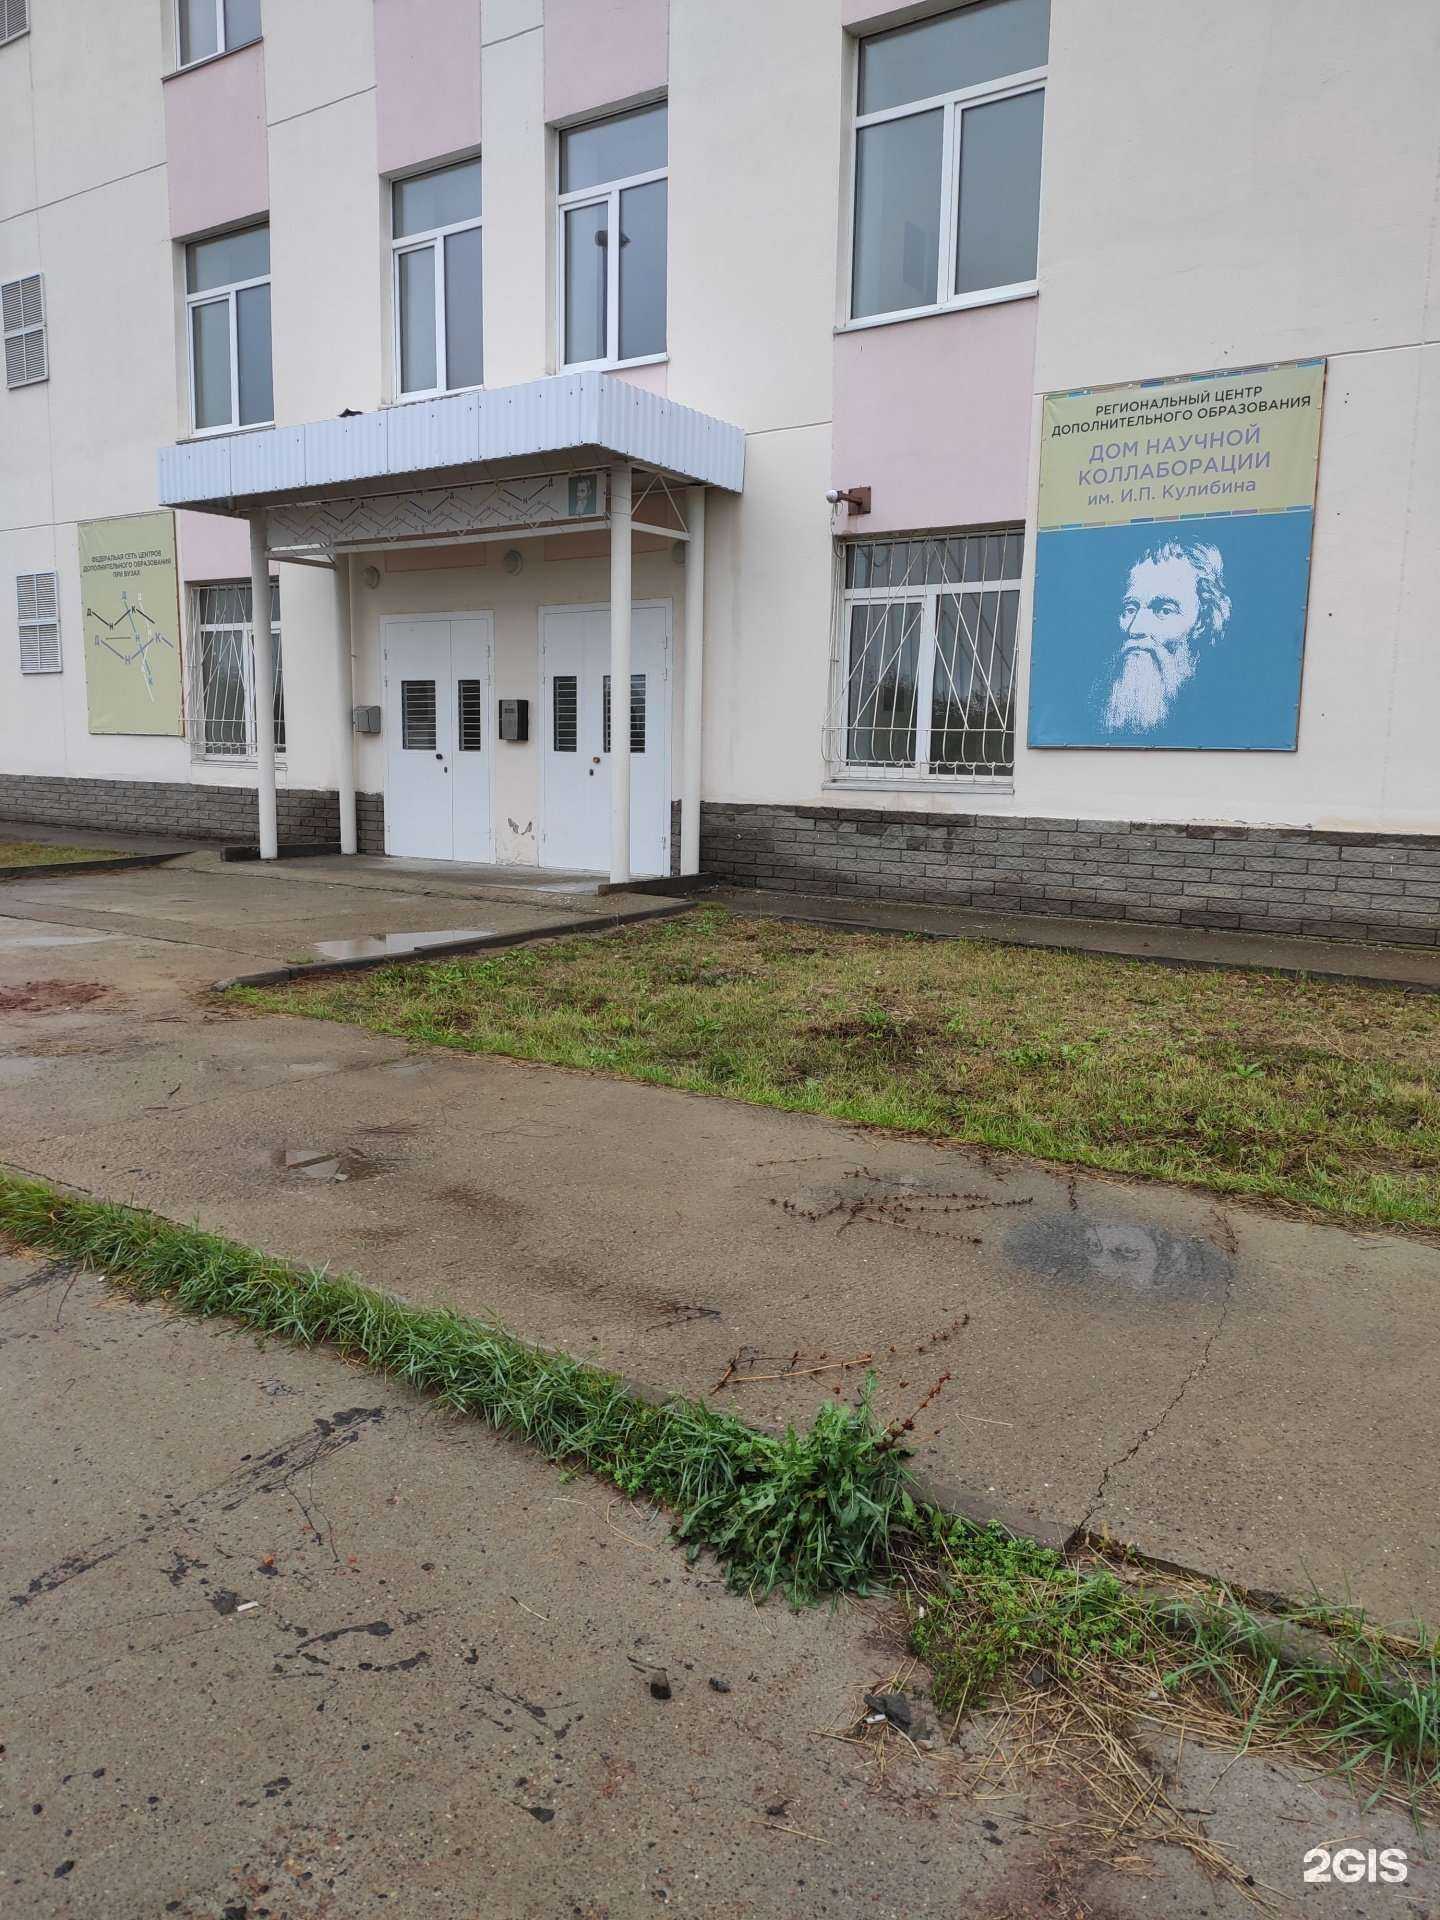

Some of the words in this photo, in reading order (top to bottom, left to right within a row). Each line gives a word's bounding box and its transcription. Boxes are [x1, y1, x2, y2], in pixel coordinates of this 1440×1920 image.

[1095, 392, 1210, 416] РЕГИОНАЛЬНЫЙ
[1215, 386, 1263, 404] ЦЕНТР
[1051, 409, 1193, 438] ДОПОЛНИТЕЛЬНОГО
[1197, 395, 1311, 419] ОБРАЗОВАНИЯ
[1088, 441, 1138, 465] ДОМ
[1146, 424, 1261, 455] НАУЧНОЙ
[1078, 451, 1271, 486] КОЛЛАБОРАЦИИ
[1087, 492, 1114, 506] им.
[1120, 486, 1155, 503] И.П.
[1162, 479, 1257, 500] Кулибина
[83, 562, 133, 573] ДОПОЛНИТЕЛЬНОГО
[134, 557, 172, 568] ОБРАЗОВАНИЯ
[124, 552, 137, 560] СЕТЬ
[138, 549, 162, 559] ЦЕНТРОВ
